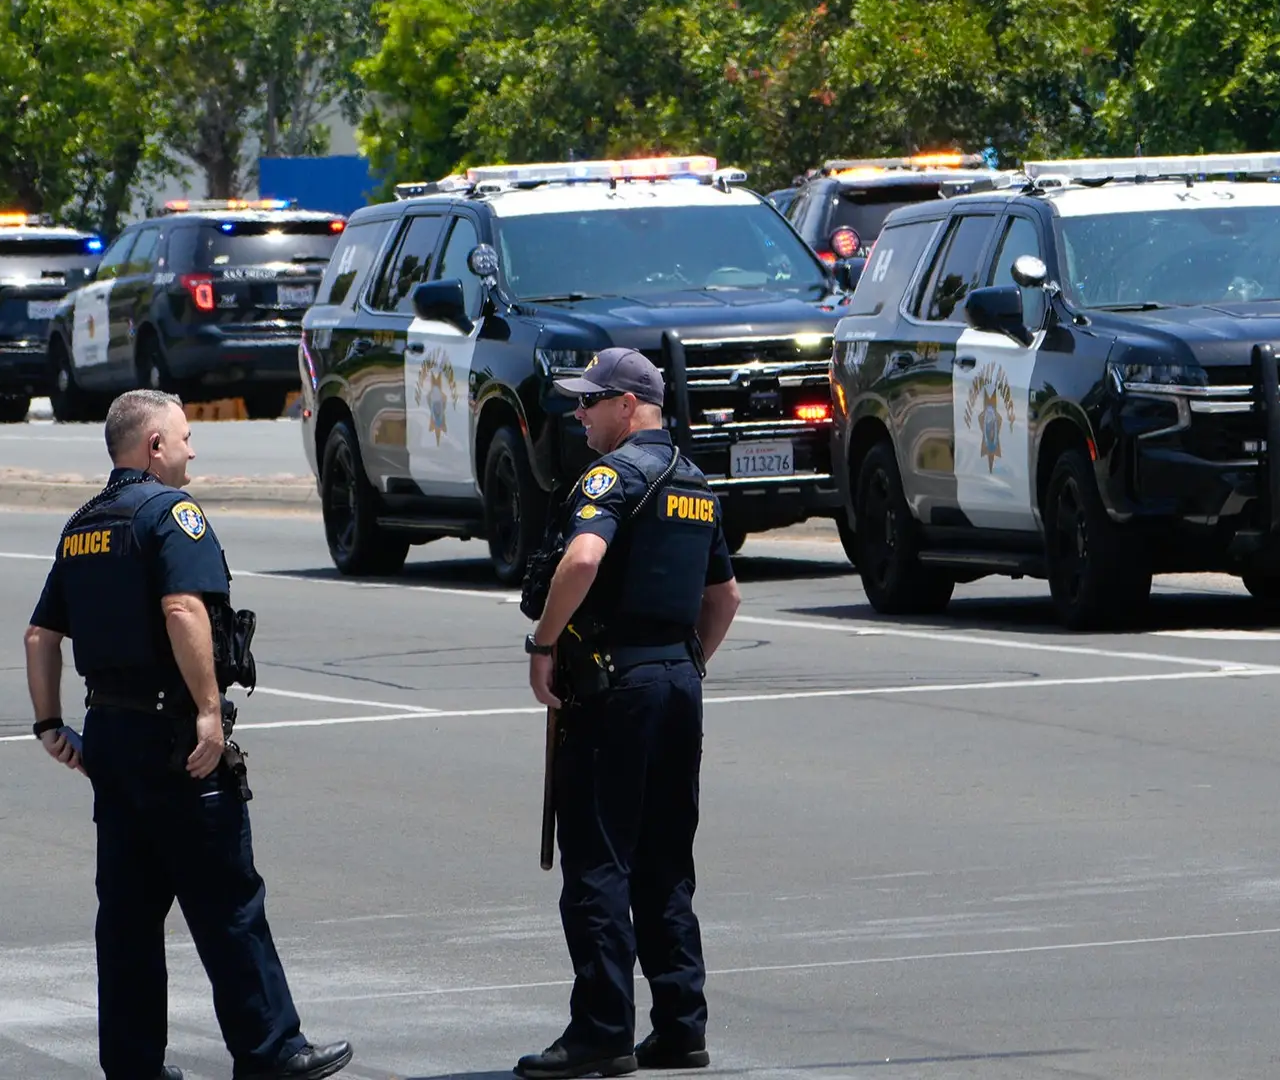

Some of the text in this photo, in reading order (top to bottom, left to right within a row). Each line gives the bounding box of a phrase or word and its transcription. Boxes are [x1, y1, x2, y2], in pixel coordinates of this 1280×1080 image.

[735, 455, 790, 473] 1713276
[667, 495, 714, 523] POLICE
[63, 529, 112, 559] POLICE
